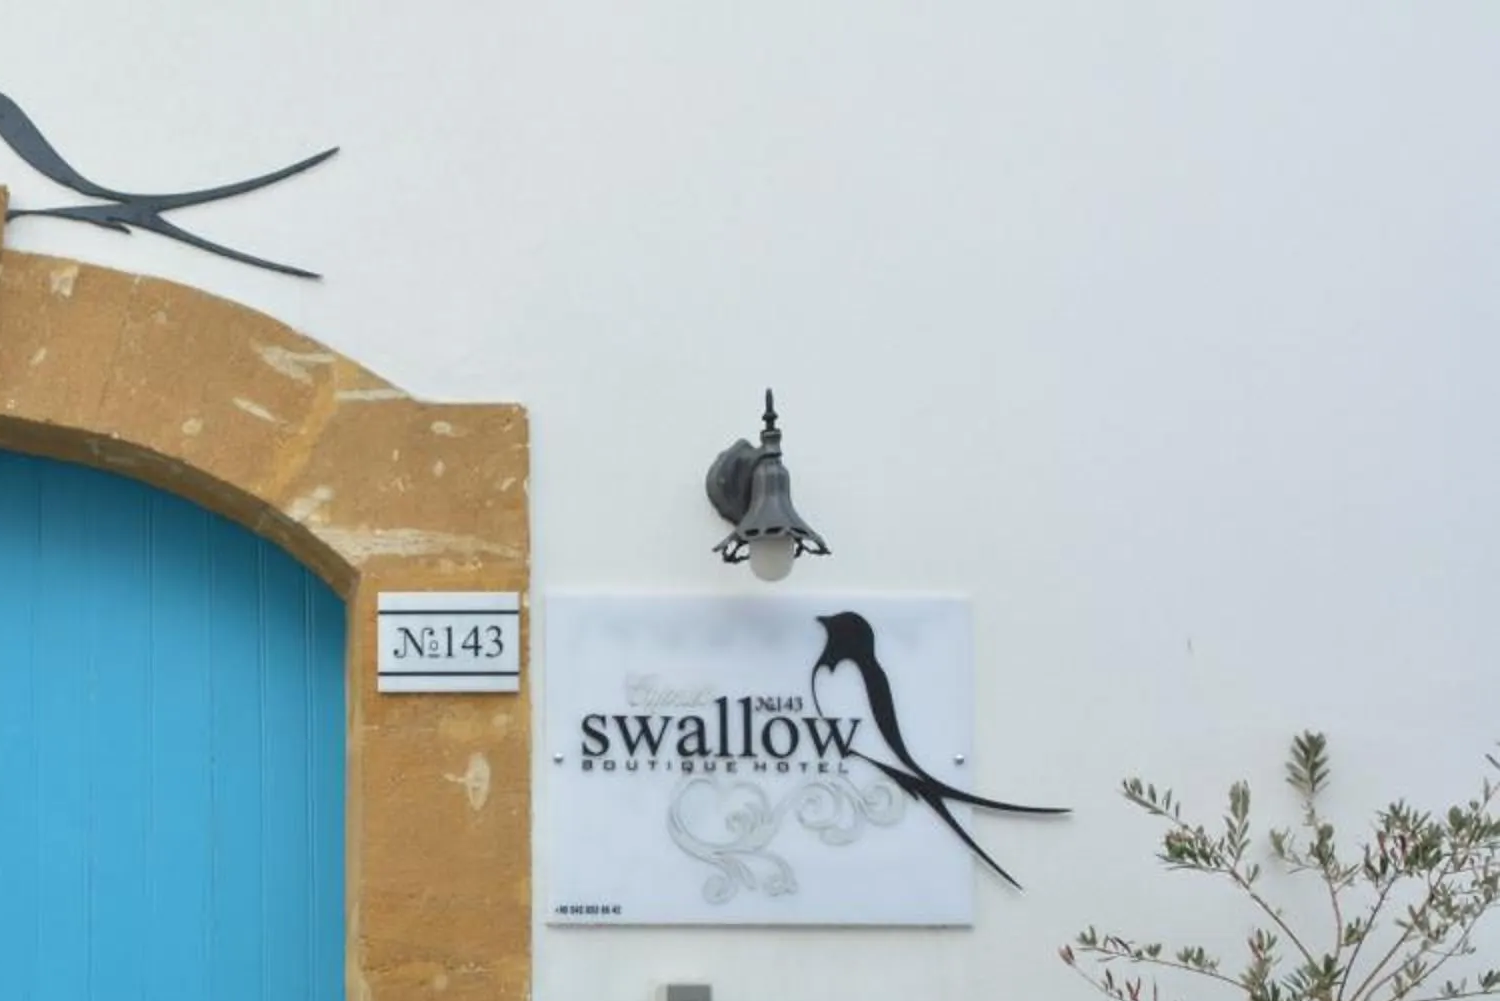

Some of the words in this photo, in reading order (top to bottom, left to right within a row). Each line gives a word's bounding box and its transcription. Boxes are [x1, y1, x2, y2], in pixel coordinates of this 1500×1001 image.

[581, 695, 863, 759] swallow
[581, 759, 739, 774] BOUTIQUE
[753, 761, 850, 774] HOTEL
